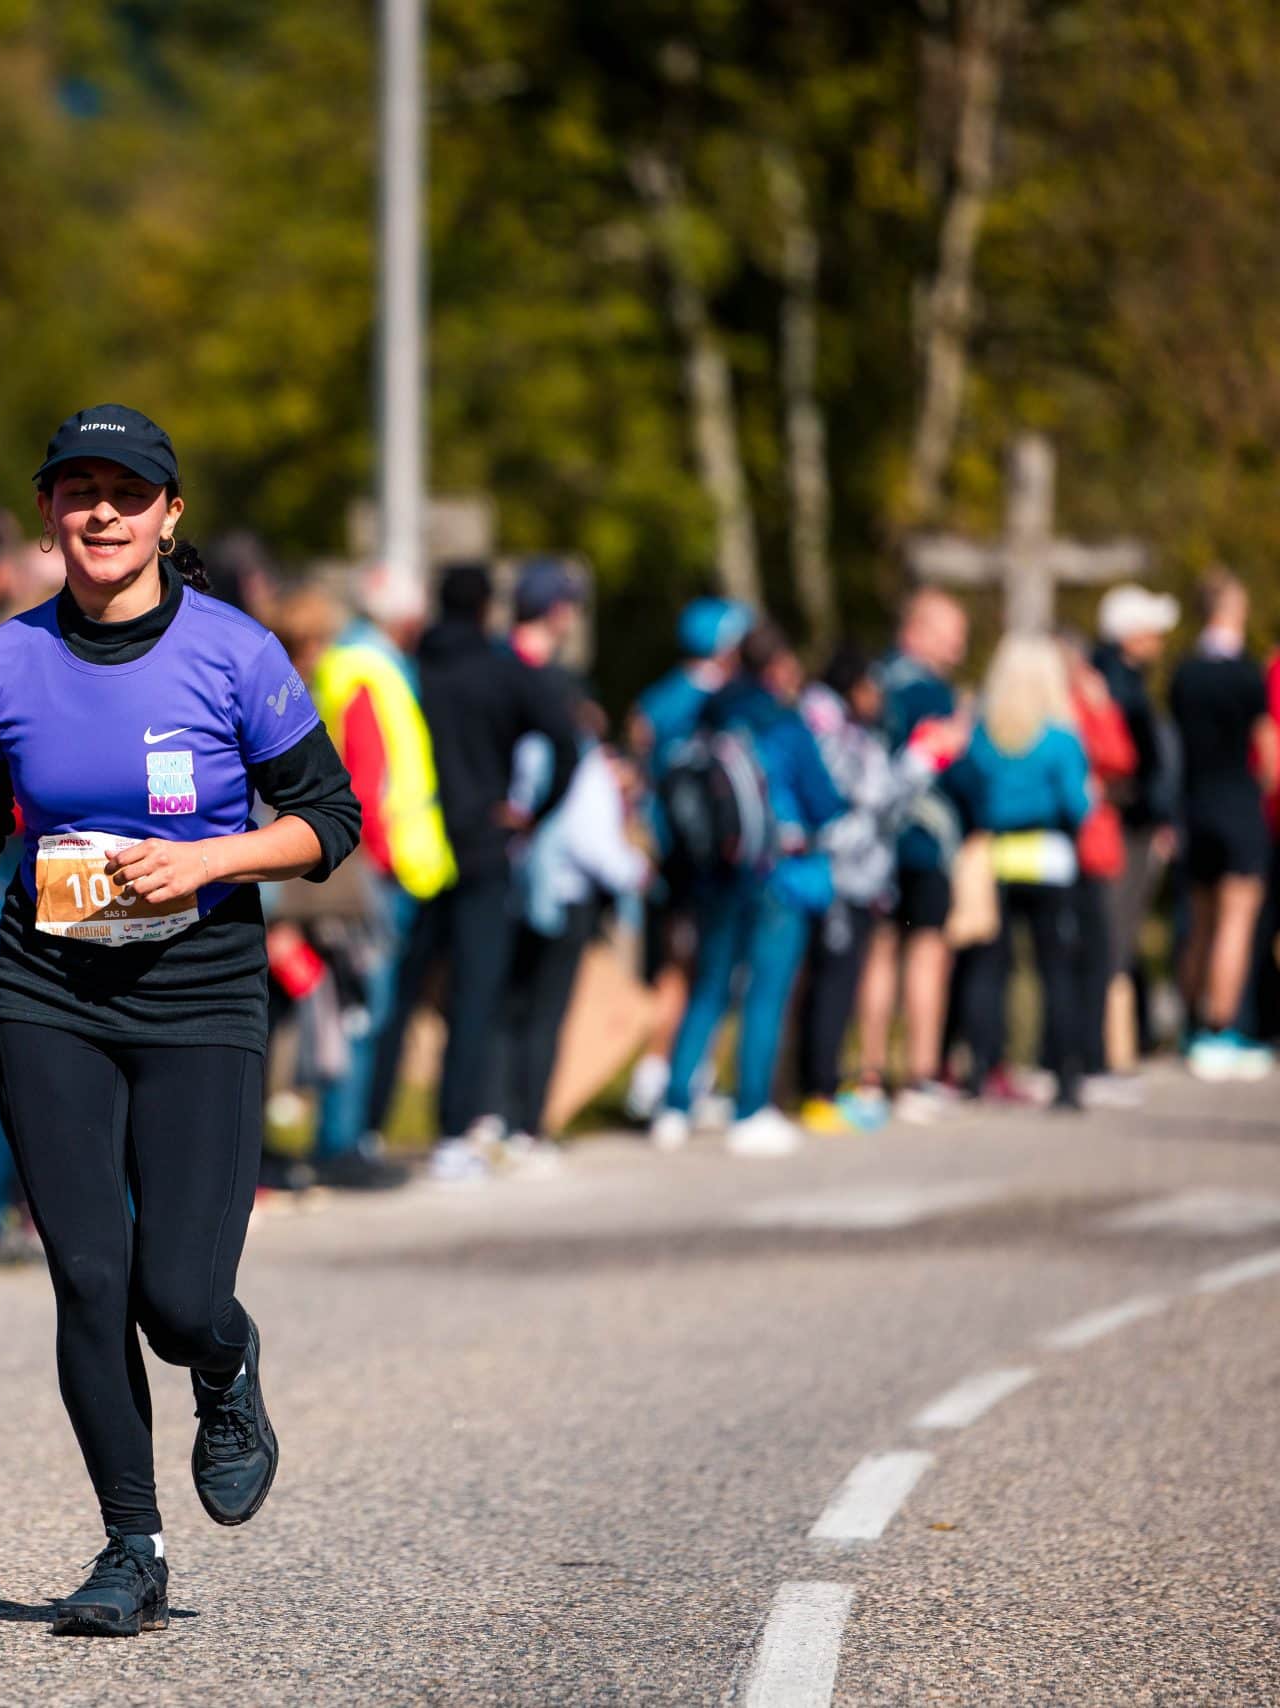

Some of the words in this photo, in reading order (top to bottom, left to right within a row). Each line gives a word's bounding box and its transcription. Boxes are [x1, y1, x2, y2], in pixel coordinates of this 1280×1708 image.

[80, 423, 126, 433] KIPRUN
[150, 795, 195, 813] NON
[104, 910, 120, 919] SAS
[121, 910, 128, 918] D
